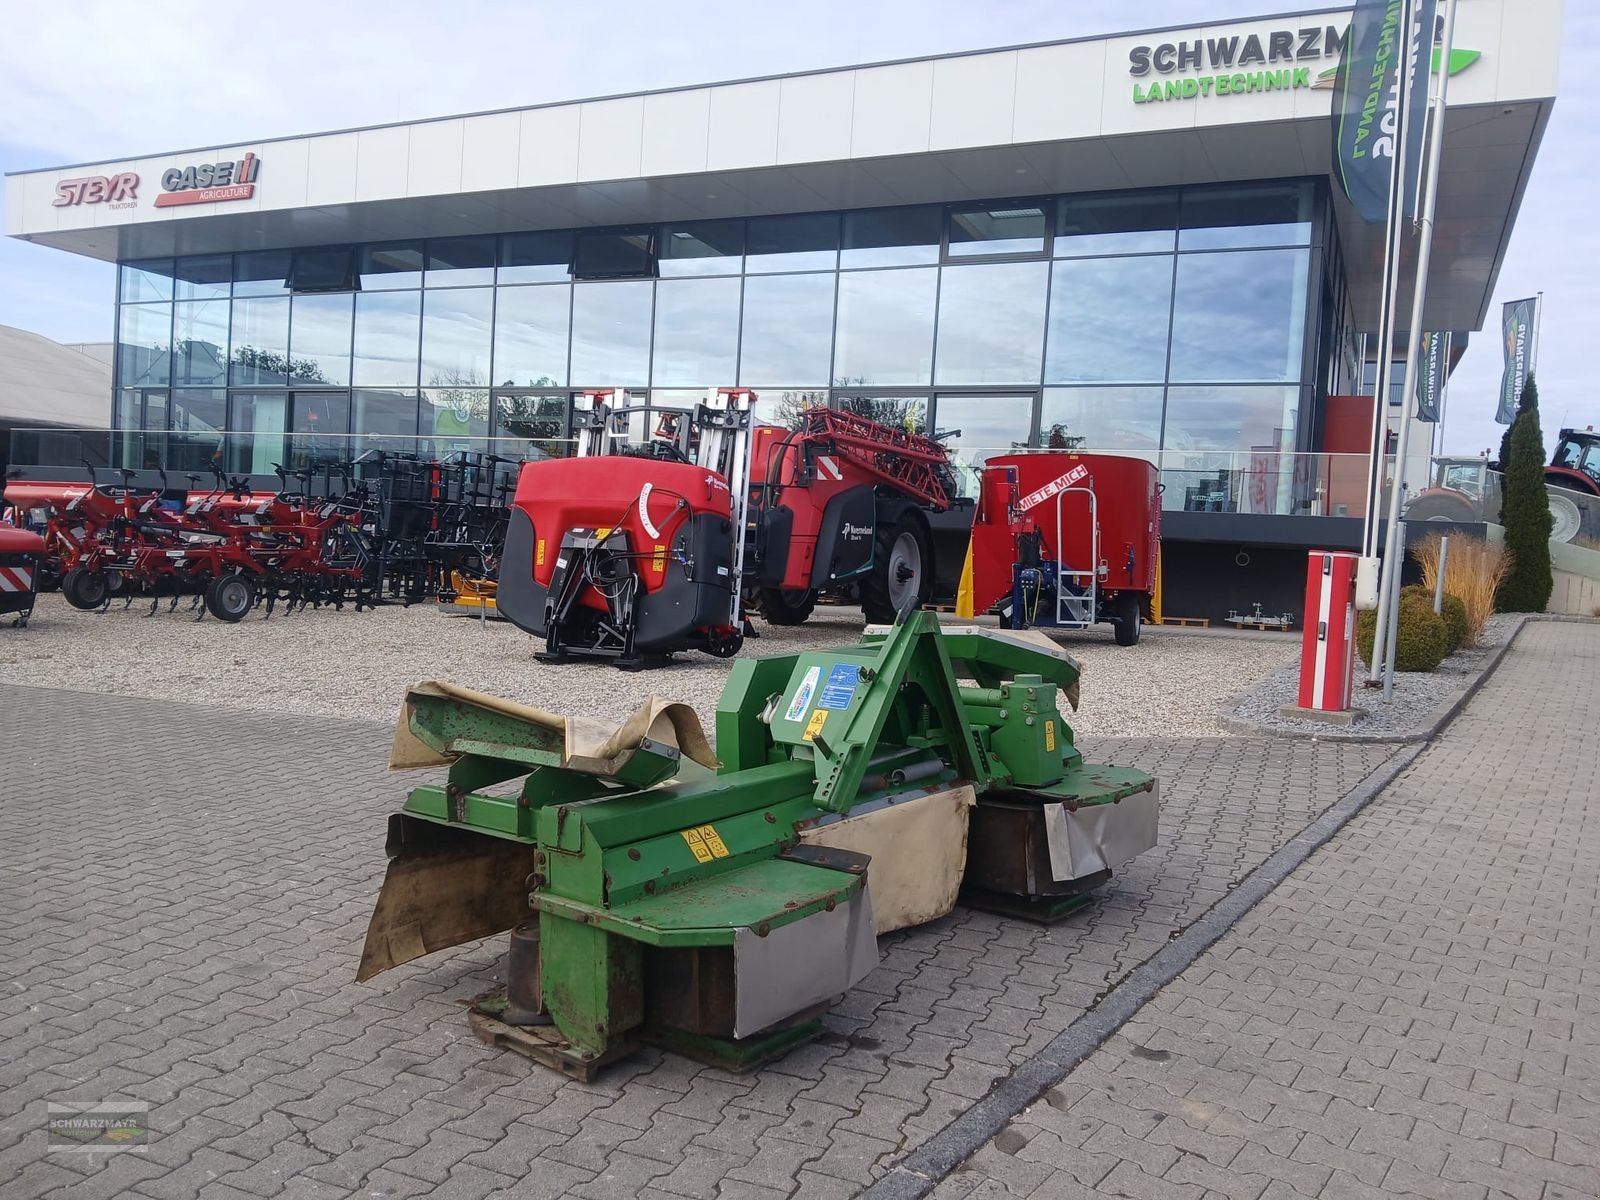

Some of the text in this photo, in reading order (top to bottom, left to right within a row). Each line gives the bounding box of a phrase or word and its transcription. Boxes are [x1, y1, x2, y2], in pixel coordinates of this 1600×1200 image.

[1133, 67, 1310, 103] LANDTECHNIK
[52, 172, 140, 207] STEYR
[199, 187, 249, 201] AGRICULTURE
[1020, 466, 1086, 509] MIETE MICH
